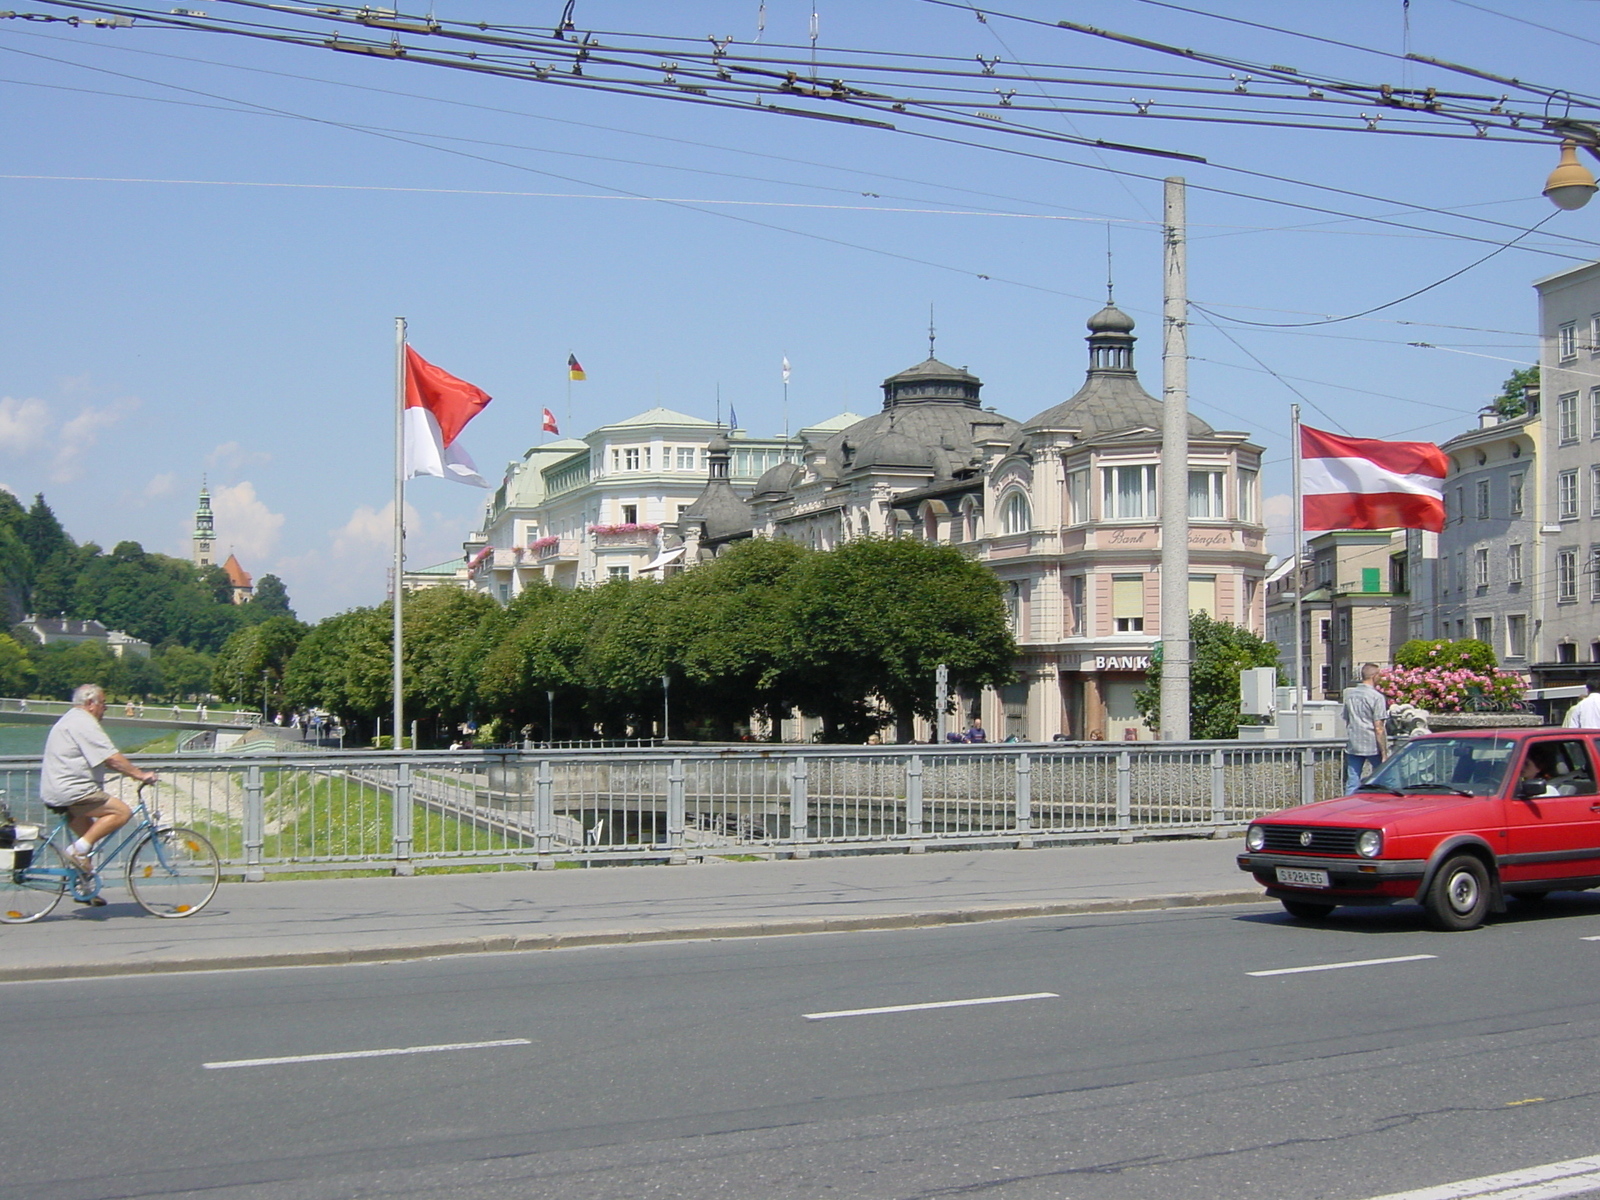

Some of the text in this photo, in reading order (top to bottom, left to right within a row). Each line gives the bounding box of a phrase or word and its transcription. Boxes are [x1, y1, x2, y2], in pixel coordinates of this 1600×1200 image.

[1108, 529, 1147, 545] Bank
[1187, 530, 1227, 547] pängler
[1095, 655, 1151, 669] BANK
